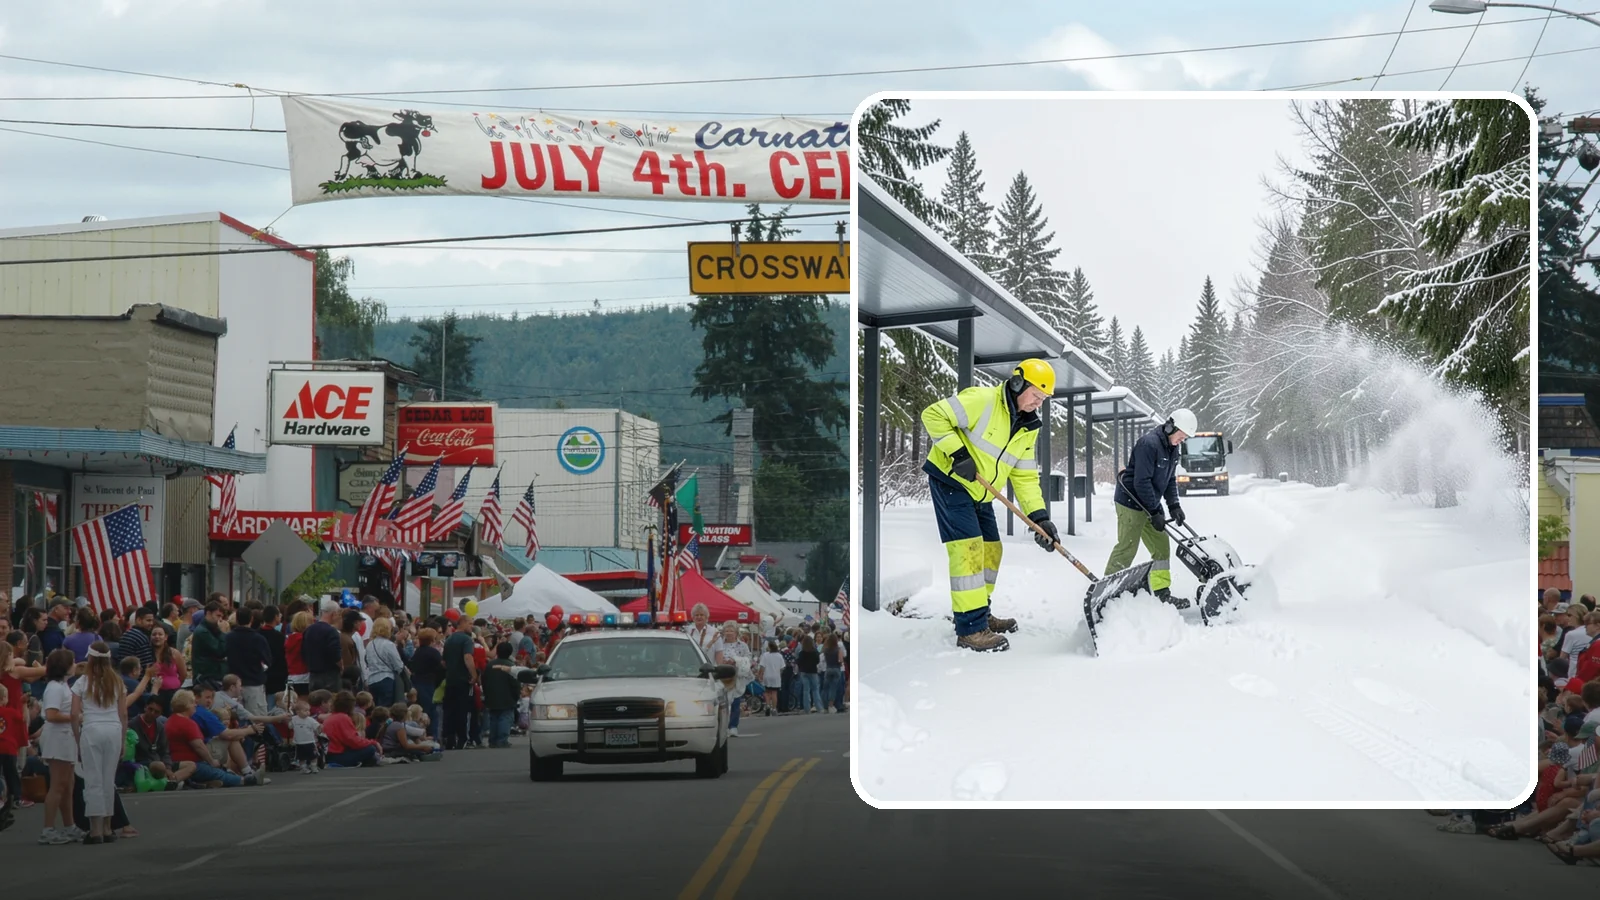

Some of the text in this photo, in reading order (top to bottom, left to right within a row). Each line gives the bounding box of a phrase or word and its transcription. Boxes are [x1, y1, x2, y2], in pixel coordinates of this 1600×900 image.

[694, 121, 850, 150] Carnat
[481, 141, 605, 192] JULY
[632, 150, 746, 198] 4th.
[697, 254, 850, 280] CROSSWA
[282, 380, 374, 420] ACE
[406, 409, 485, 422] CEDAR LOG
[283, 421, 371, 437] Hardware
[416, 428, 477, 447] Coca-Cola
[353, 467, 385, 481] Simpl
[83, 485, 155, 496] St. Vincent de Paul
[688, 526, 742, 536] CRNATION
[699, 535, 730, 543] GLASS
